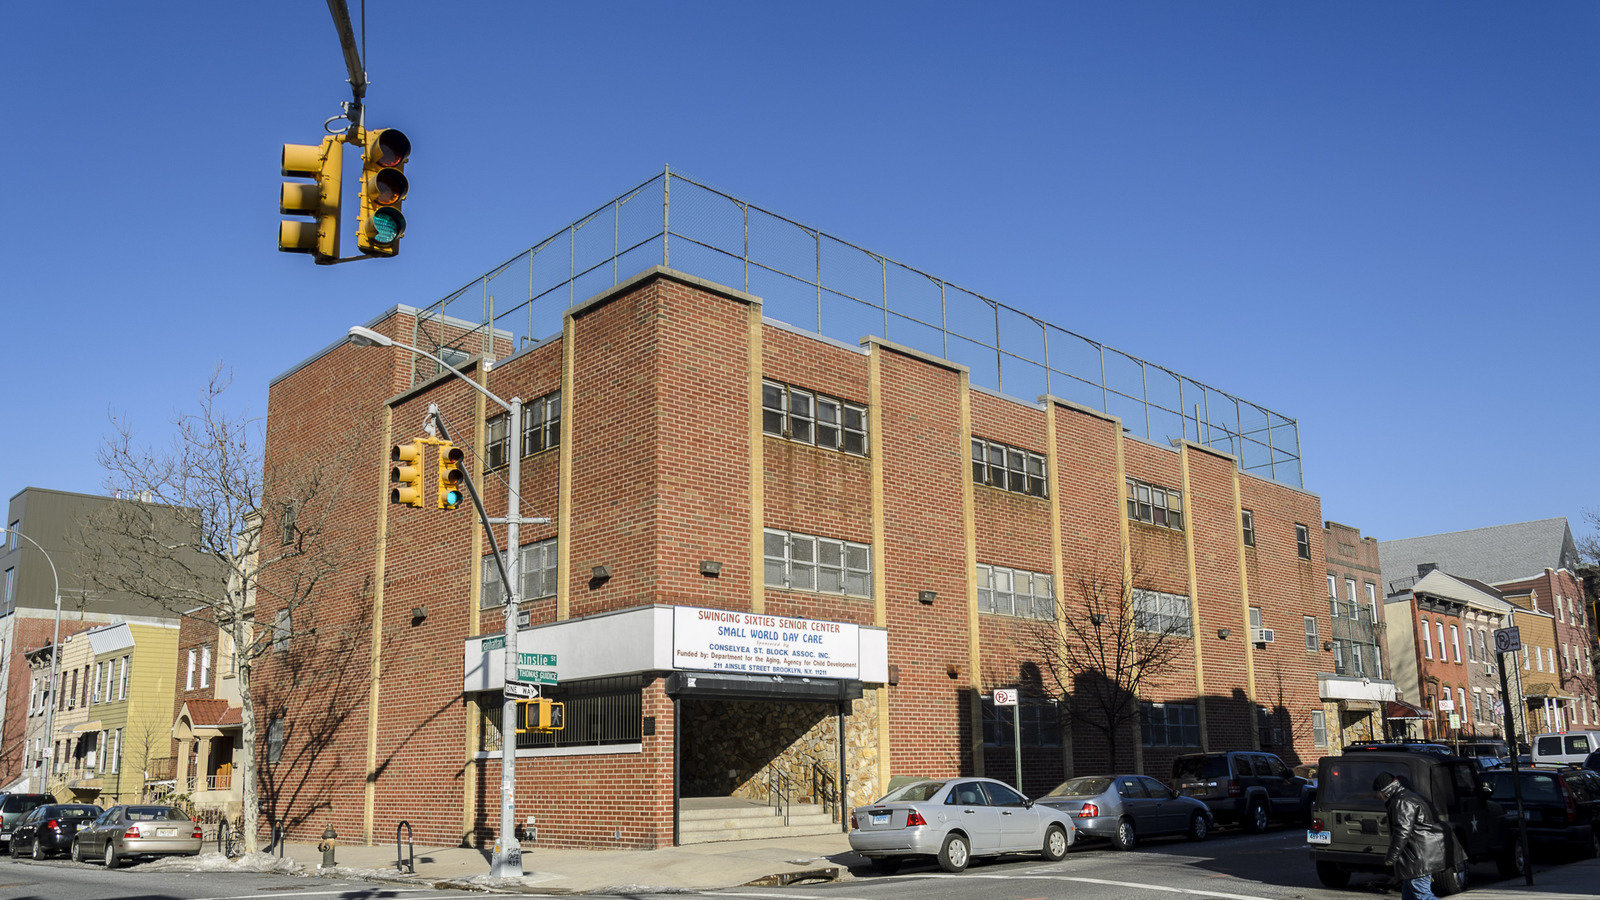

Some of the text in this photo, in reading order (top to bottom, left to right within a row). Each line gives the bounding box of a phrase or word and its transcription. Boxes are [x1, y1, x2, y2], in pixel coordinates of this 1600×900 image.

[698, 610, 840, 633] SWINGING SIXTIES SENIOR CENTER
[718, 626, 823, 644] SMALL WORLD DAY CARE
[709, 644, 750, 653] CONSELYEA
[518, 653, 548, 666] Ainslie
[676, 650, 698, 658] Funded
[700, 651, 708, 659] by:
[711, 652, 742, 661] Department
[766, 656, 781, 665] Aging,
[784, 658, 802, 667] Agency
[519, 669, 538, 678] THOMAS
[506, 685, 517, 694] ONE
